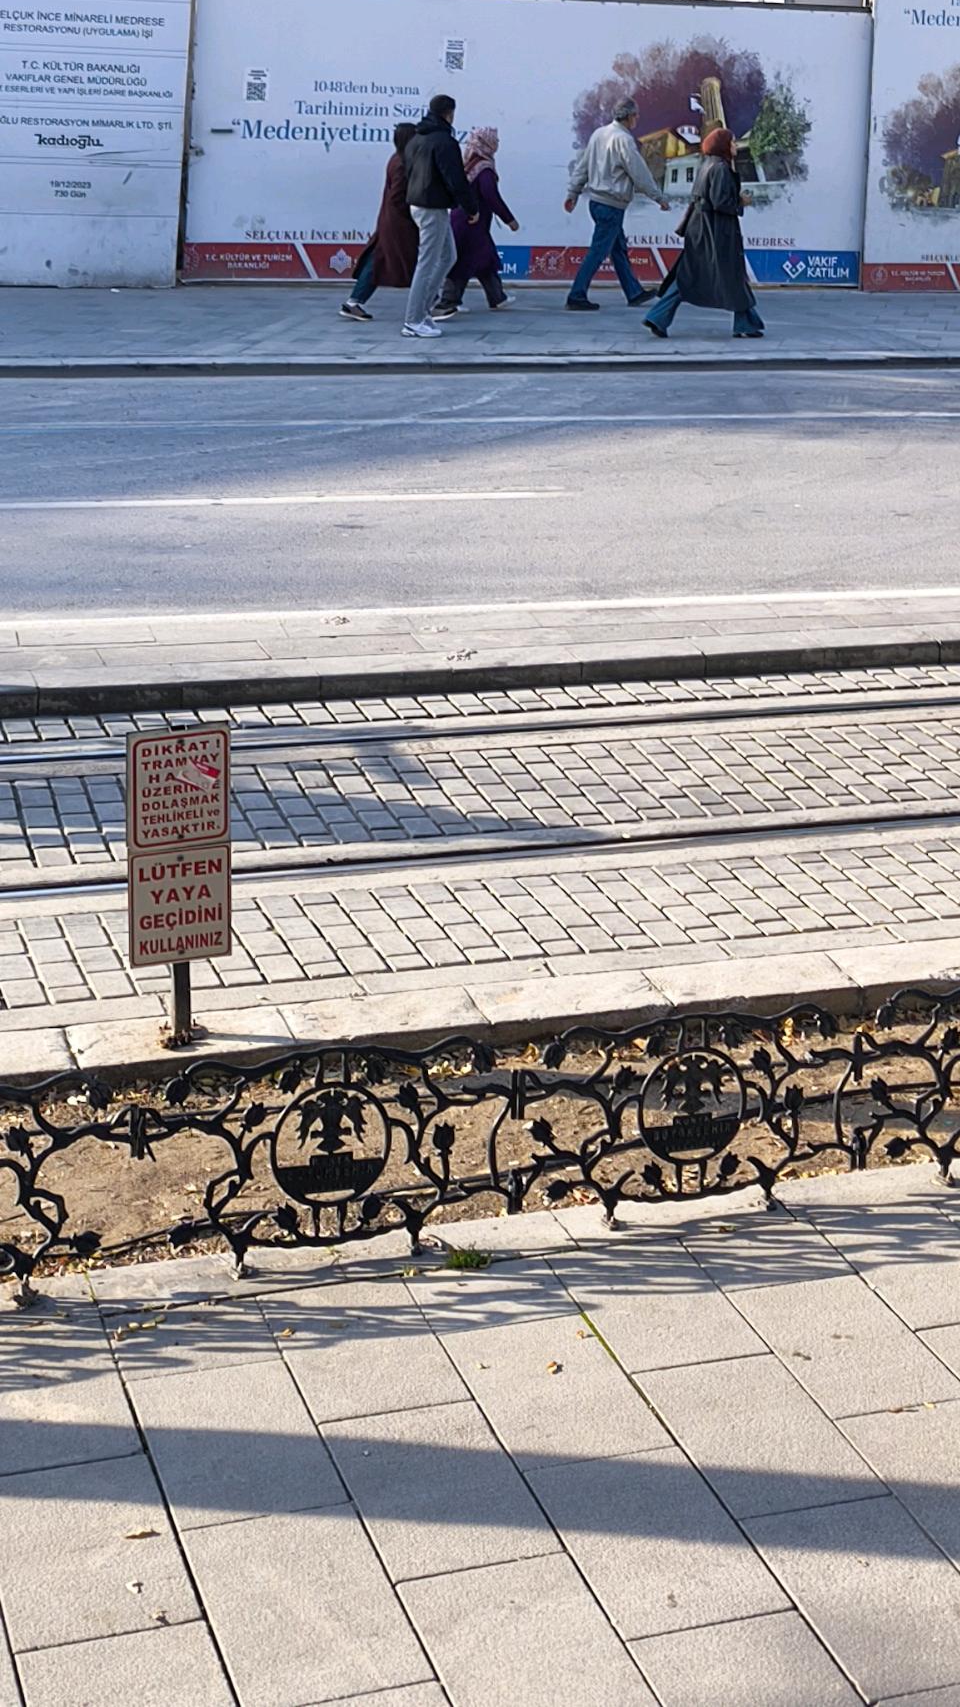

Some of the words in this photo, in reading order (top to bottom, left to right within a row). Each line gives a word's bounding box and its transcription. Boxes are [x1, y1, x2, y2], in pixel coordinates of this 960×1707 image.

[37, 10, 61, 22] İNCE
[64, 12, 112, 24] MİNARELİ
[116, 16, 165, 26] MEDRESE
[4, 24, 80, 35] RESTORASYONU
[83, 28, 139, 38] (UYGULAMA)
[43, 60, 84, 72] KÜLTÜR
[87, 62, 140, 74] BAKANLIĞI
[6, 74, 50, 82] VAKIFLAR
[54, 75, 84, 84] GENEL
[88, 75, 147, 86] MÜDÜRLÜĞÜ
[314, 80, 368, 94] 1048'den
[371, 82, 388, 94] bu
[388, 86, 420, 96] yana
[295, 100, 389, 117] Tarihimizin
[393, 103, 428, 118] Sözü
[21, 116, 90, 127] RESTORASYON
[137, 121, 155, 130] LTD.
[245, 230, 306, 241] SELÇUKLU
[311, 229, 339, 240] İNCE
[747, 238, 796, 246] MEDRESE
[808, 256, 838, 267] VAKIF
[807, 267, 850, 279] KATILIM
[141, 740, 210, 758] DİKKAT
[141, 753, 220, 771] TRAMVAY
[142, 794, 220, 812] DOLAŞMAK
[141, 808, 204, 826] TEHLİKELİ
[207, 809, 220, 818] ve
[142, 821, 220, 839] YASAKTIR.
[138, 858, 222, 882] LÜTFEN
[150, 884, 211, 905] YAYA
[140, 902, 222, 932] GEÇİDİNİ
[140, 931, 223, 956] KULLANINIZ
